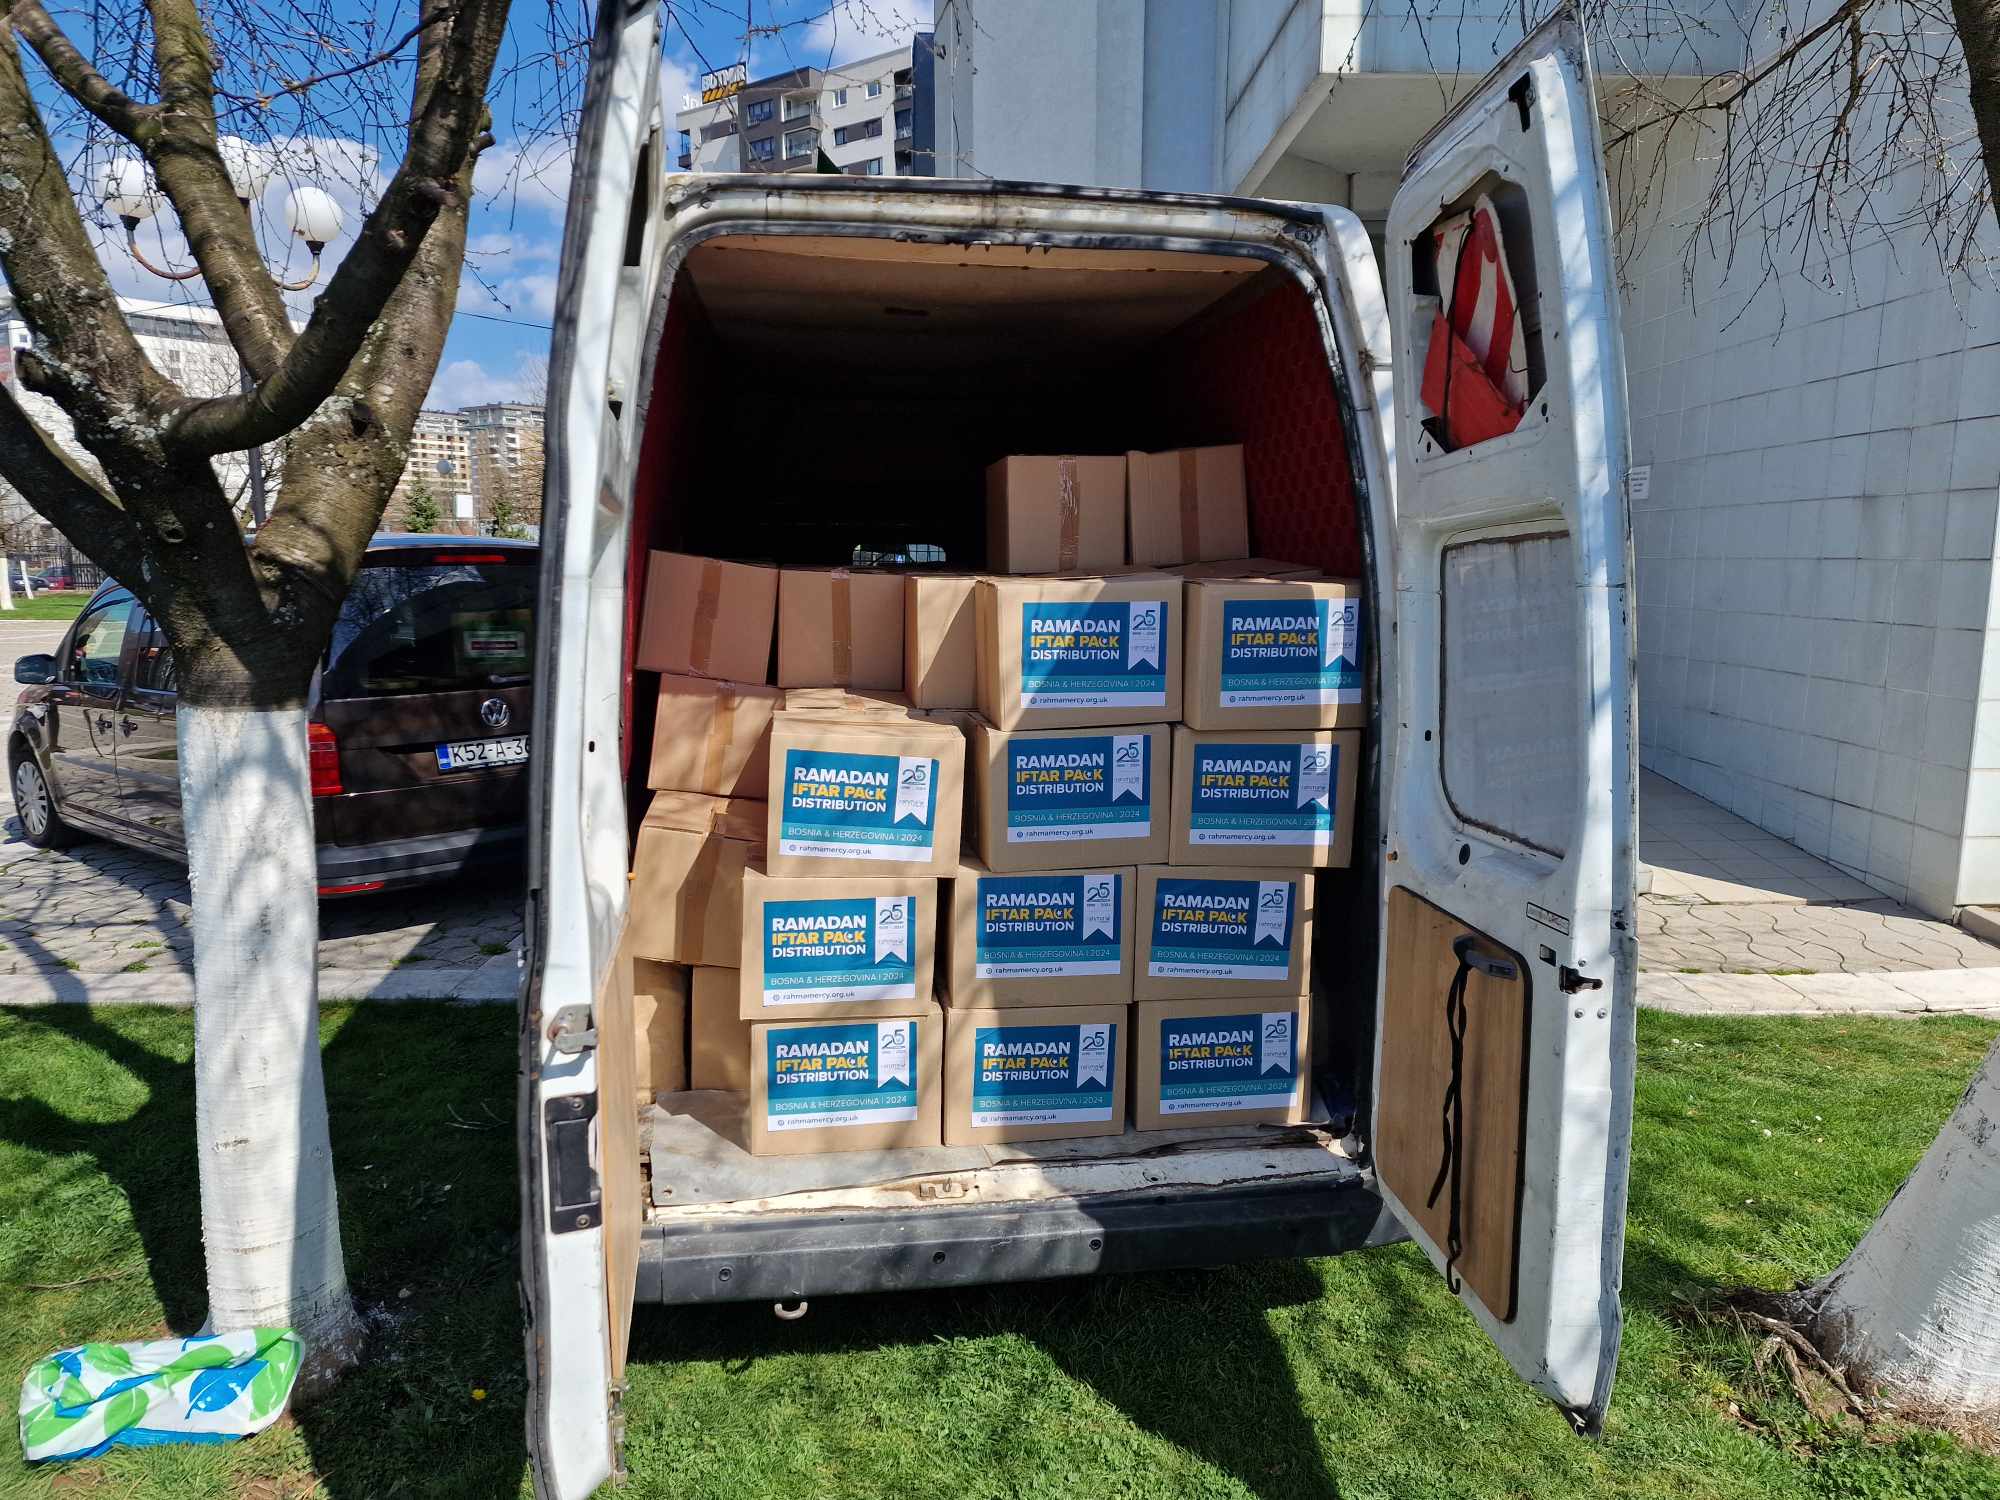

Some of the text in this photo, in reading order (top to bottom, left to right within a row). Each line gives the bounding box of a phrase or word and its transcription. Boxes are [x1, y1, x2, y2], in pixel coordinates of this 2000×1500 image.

[1133, 610, 1155, 630] 25
[1331, 606, 1353, 627] 25
[1031, 620, 1120, 633] RAMADAN
[1231, 617, 1319, 631] RAMADAN
[1031, 636, 1119, 647] IFTAR PACK
[1230, 633, 1274, 645] IFTAR
[1279, 633, 1318, 645] PACK
[1031, 650, 1119, 660] DISTRIBUTION
[1230, 647, 1317, 658] DISTRIBUTION
[1116, 743, 1138, 763] 25
[1016, 753, 1104, 768] RAMADAN
[1202, 760, 1290, 773] RAMADAN
[1303, 751, 1326, 771] 25
[794, 767, 888, 786] RAMADAN
[901, 764, 926, 786] 25
[1016, 770, 1059, 783] IFTAR
[1064, 769, 1103, 781] PACK
[1201, 775, 1289, 787] IFTAR PACK
[793, 783, 887, 800] IFTAR PACK
[1016, 782, 1104, 795] DISTRIBUTION
[1201, 788, 1289, 799] DISTRIBUTION
[792, 797, 886, 813] DISTRIBUTION
[1015, 814, 1046, 822] BOSNIA
[788, 828, 822, 837] BOSNIA
[834, 830, 894, 840] HERZEGOVINA
[902, 834, 922, 842] 2024
[986, 892, 1074, 906] RAMADAN
[1086, 883, 1109, 902] 25
[1261, 889, 1284, 908] 25
[1163, 895, 1249, 909] RAMADAN
[879, 904, 903, 925] 25
[985, 908, 1029, 920] IFTAR
[1034, 908, 1073, 920] PACK
[1162, 909, 1247, 923] IFTAR PACK
[773, 915, 866, 931] RAMADAN
[985, 921, 1074, 932] DISTRIBUTION
[1161, 922, 1246, 935] DISTRIBUTION
[772, 932, 819, 945] IFTAR
[824, 931, 865, 944] PACK
[773, 944, 866, 958] DISTRIBUTION
[984, 951, 1015, 959] BOSNIA
[1157, 951, 1188, 959] BOSNIA
[1198, 952, 1253, 961] HERZEGOVINA
[771, 977, 804, 985] BOSNIA
[816, 974, 876, 983] HERZEGOVINA
[1265, 1020, 1286, 1039] 25
[881, 1030, 905, 1050] 25
[1082, 1032, 1104, 1051] 25
[1169, 1030, 1253, 1046] RAMADAN
[777, 1041, 869, 1058] RAMADAN
[983, 1041, 1070, 1056] RAMADAN
[1169, 1047, 1210, 1059] IFTAR
[1215, 1044, 1252, 1057] PACK
[776, 1058, 822, 1072] IFTAR
[827, 1056, 868, 1069] PACK
[982, 1057, 1026, 1069] IFTAR
[1031, 1056, 1069, 1068] PACK
[1169, 1057, 1252, 1070] DISTRIBUTION
[777, 1069, 869, 1084] DISTRIBUTION
[982, 1069, 1069, 1081] DISTRIBUTION
[1207, 1084, 1261, 1093] HERZEGOVINA
[775, 1102, 808, 1110] BOSNIA
[819, 1098, 879, 1108] HERZEGOVINA
[1021, 1098, 1077, 1106] HERZEGOVINA
